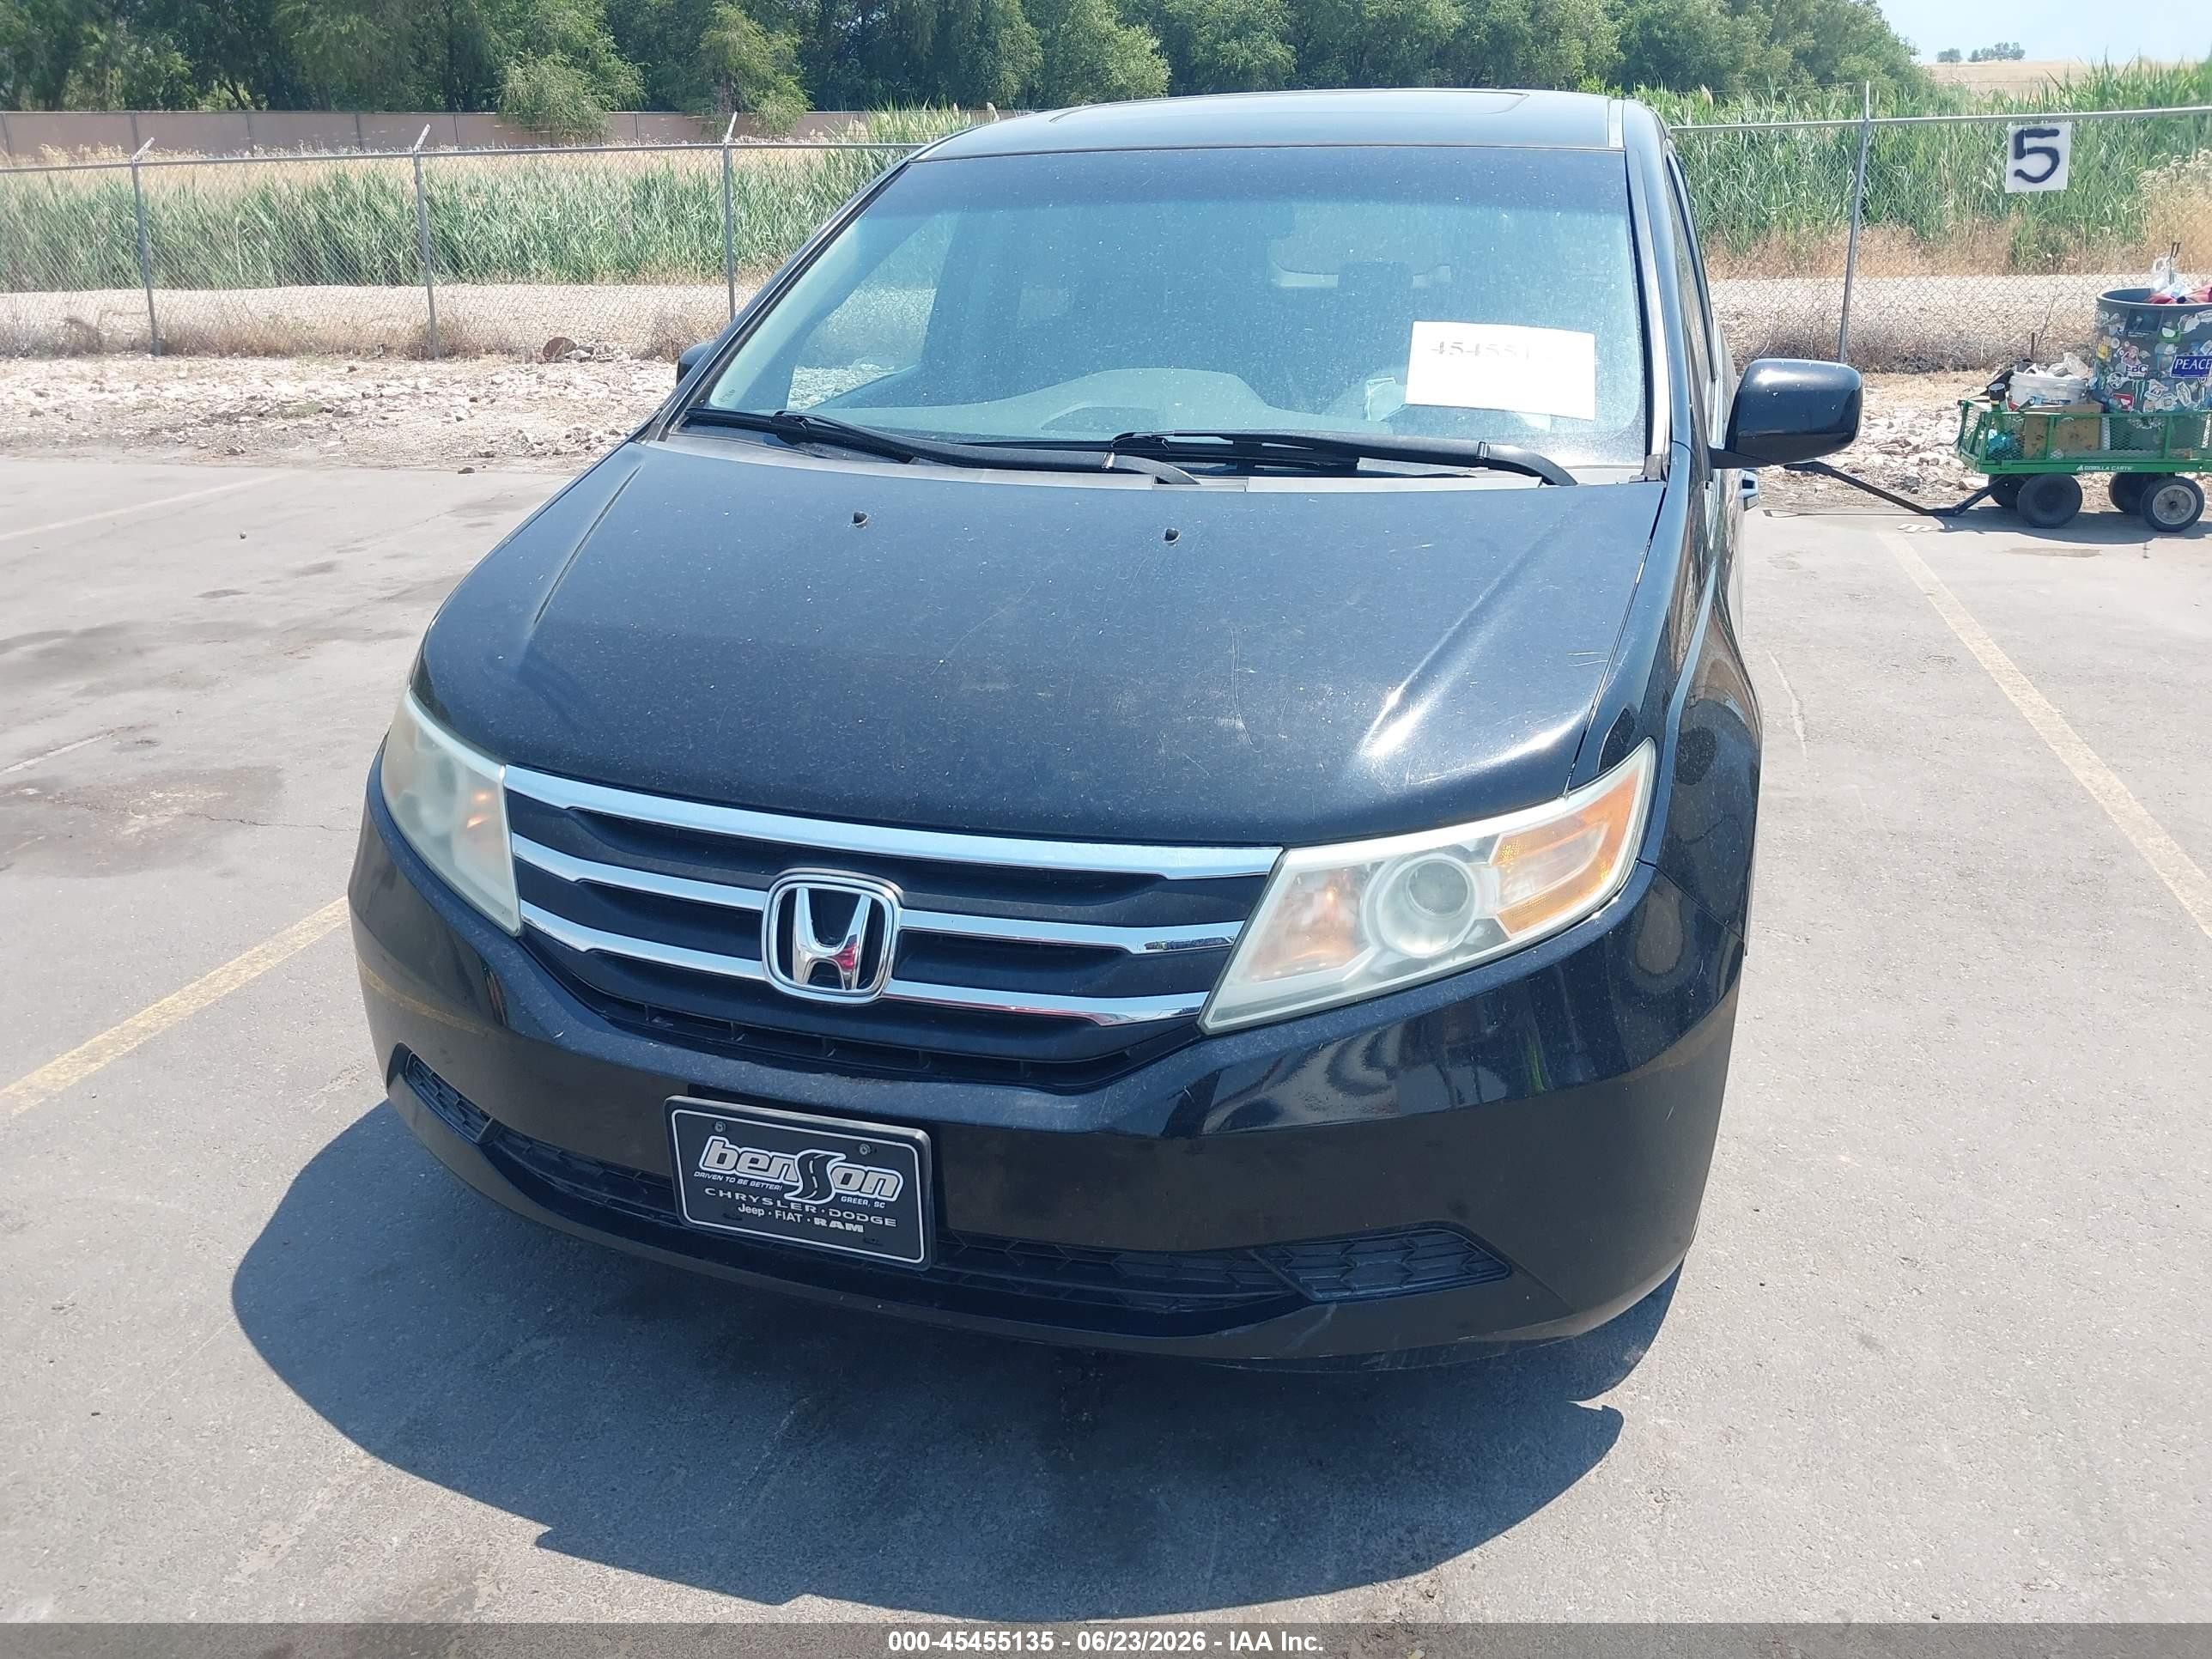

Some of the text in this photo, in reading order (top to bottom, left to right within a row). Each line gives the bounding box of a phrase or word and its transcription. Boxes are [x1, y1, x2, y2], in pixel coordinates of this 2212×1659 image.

[2014, 128, 2060, 184] 5
[2174, 358, 2212, 370] PEACE
[693, 1170, 724, 1182] DRIVEN
[750, 1182, 783, 1192] BETTER!
[704, 1188, 897, 1228] CHRYSLER DODGE
[841, 1195, 886, 1209] GREER, SC
[738, 1203, 865, 1233] Jeep FIAT RAM
